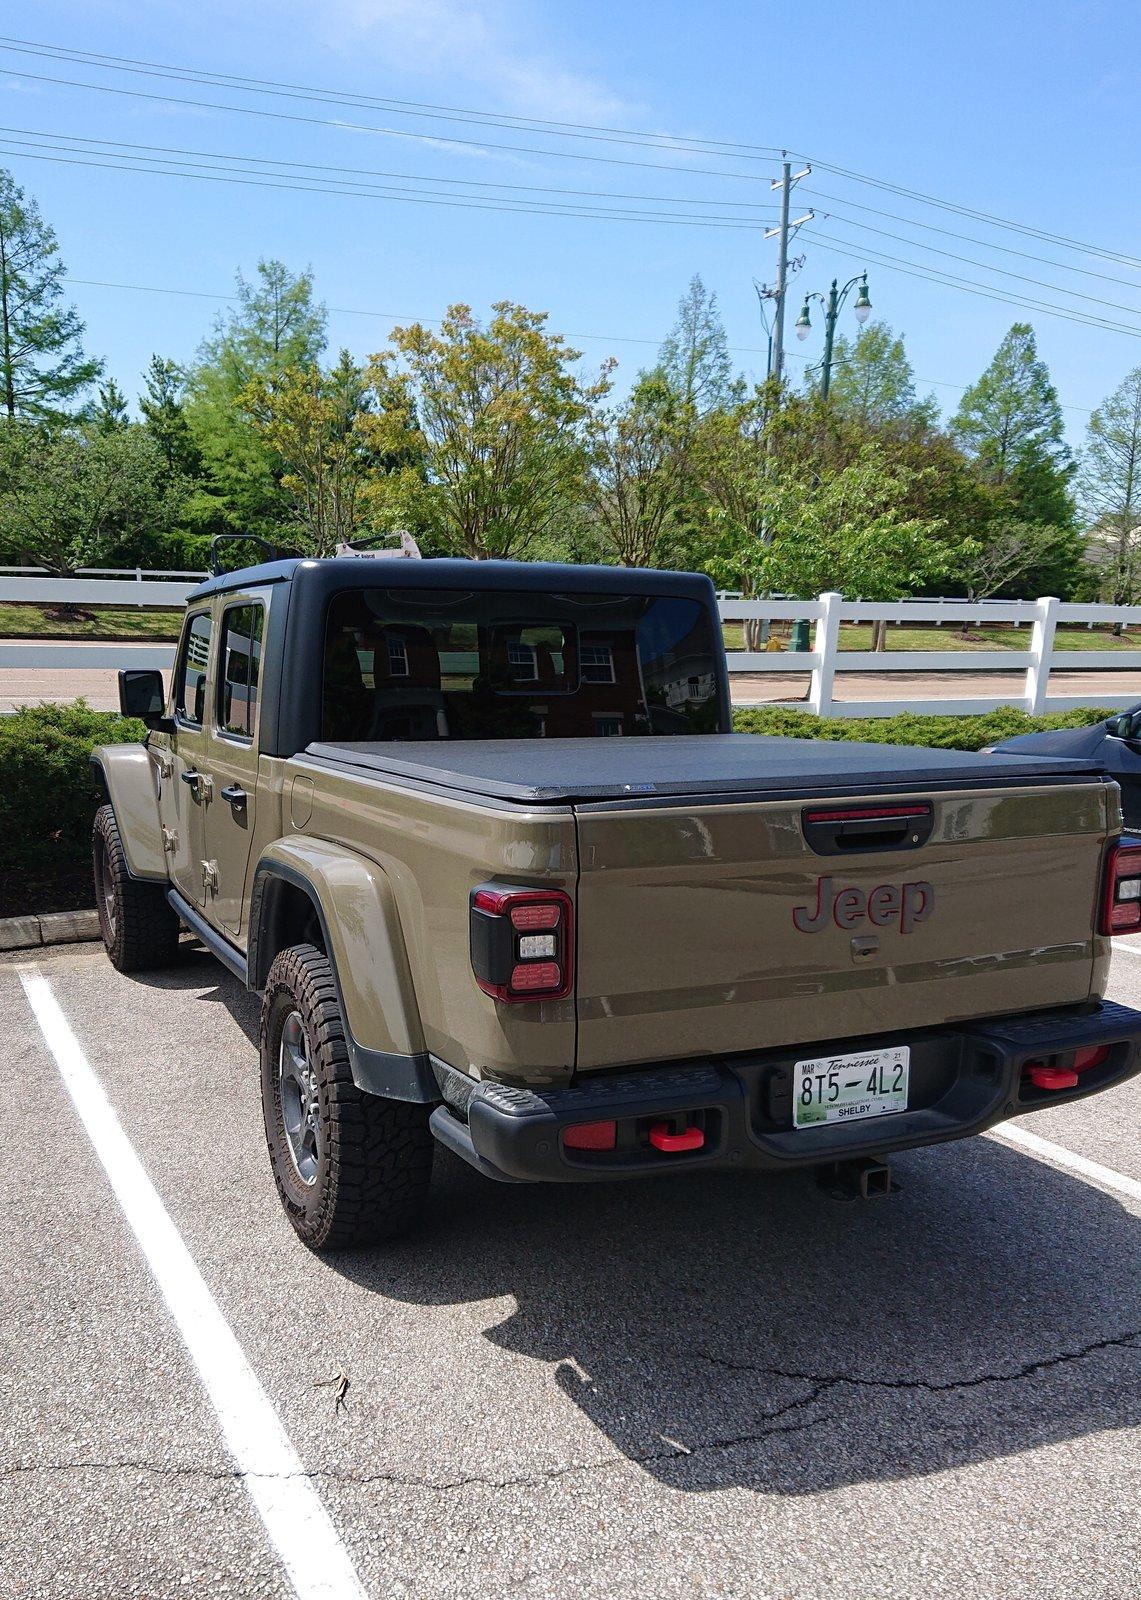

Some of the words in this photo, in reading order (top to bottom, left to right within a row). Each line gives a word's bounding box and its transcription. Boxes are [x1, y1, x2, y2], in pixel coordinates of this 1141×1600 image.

[793, 876, 934, 934] Jeep
[802, 1063, 815, 1076] MAR
[826, 1058, 880, 1074] Tennessee
[838, 1104, 871, 1117] SHELBY
